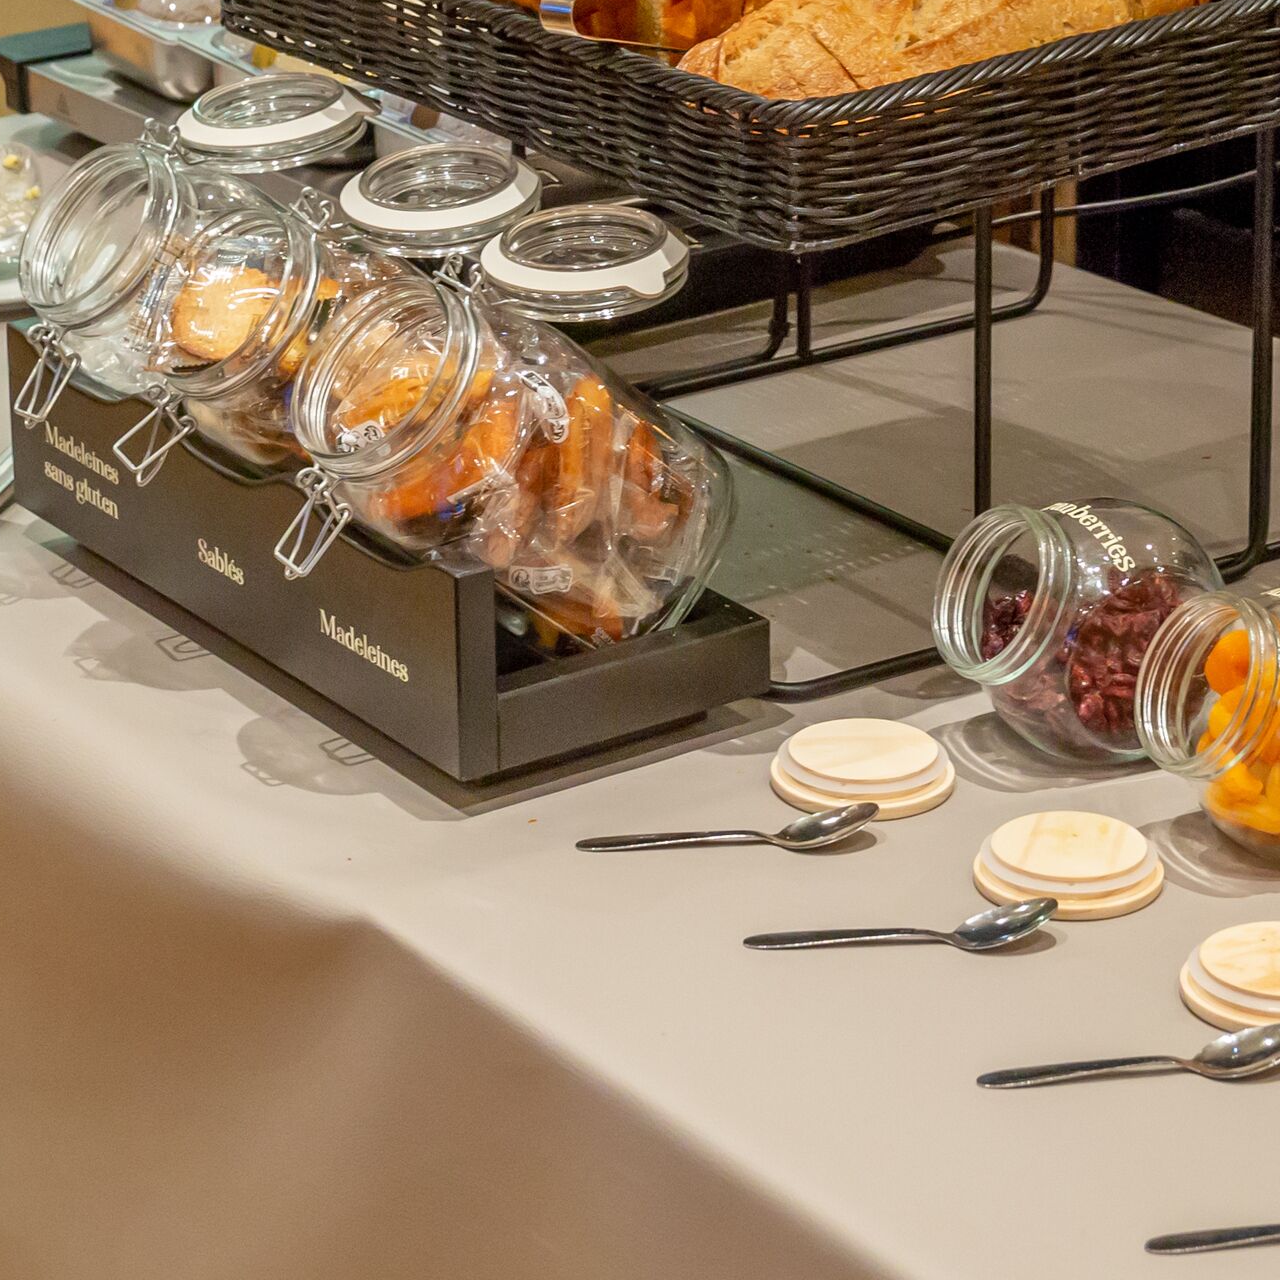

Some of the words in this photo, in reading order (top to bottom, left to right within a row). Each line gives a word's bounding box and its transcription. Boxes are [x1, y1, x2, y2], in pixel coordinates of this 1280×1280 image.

[44, 419, 119, 485] Madeleines
[44, 461, 74, 491] sans
[76, 478, 119, 520] gluten
[197, 537, 245, 585] Sablés
[320, 608, 409, 683] Madeleines
